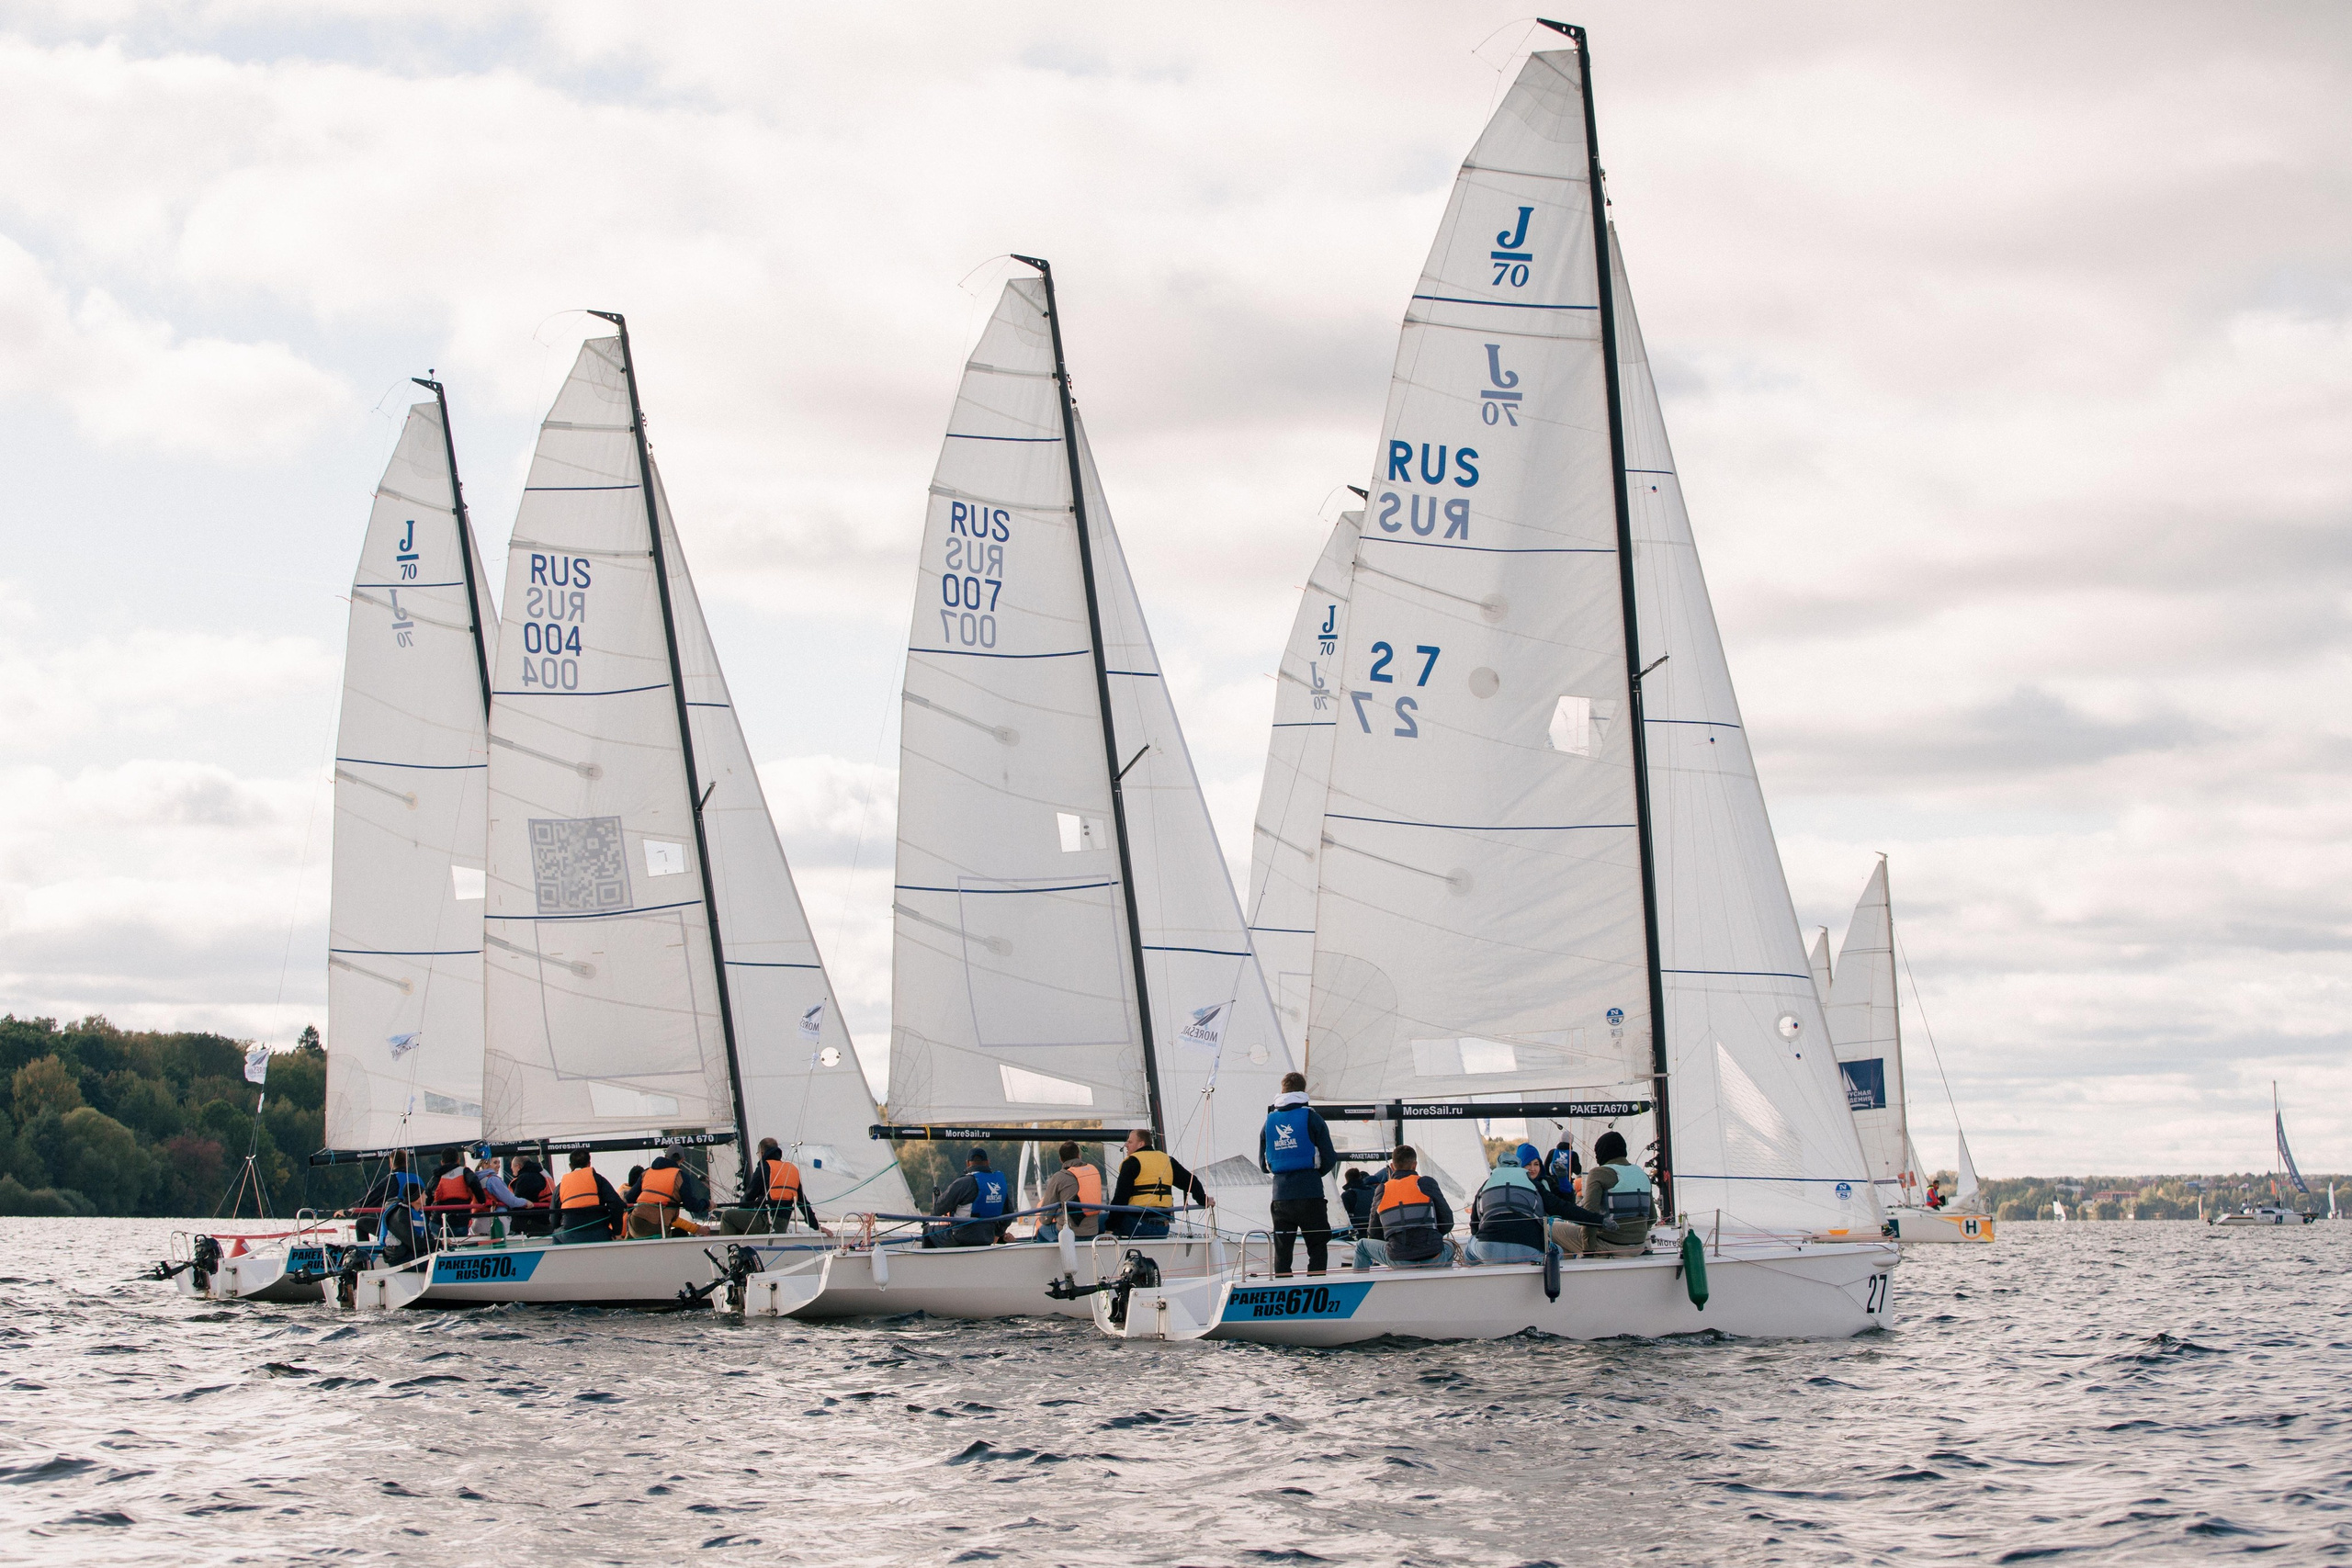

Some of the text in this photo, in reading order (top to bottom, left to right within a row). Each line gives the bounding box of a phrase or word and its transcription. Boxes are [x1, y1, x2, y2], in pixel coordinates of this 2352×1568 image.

[1496, 206, 1535, 250] J
[1492, 262, 1530, 288] 70
[1388, 439, 1479, 488] RUS
[399, 520, 415, 552] J
[951, 501, 1010, 543] RUS
[400, 563, 418, 581] 70
[531, 553, 592, 589] RUS
[942, 573, 1002, 613] 007
[1321, 604, 1337, 634] J
[524, 622, 582, 657] 004
[1320, 641, 1335, 656] 70
[1403, 1106, 1463, 1115] MoreSail.ru
[548, 1142, 591, 1150] moresail.ru
[695, 1134, 714, 1143] 670
[945, 1129, 990, 1138] MoreSail.ru
[456, 1268, 479, 1280] RUS
[479, 1256, 512, 1279] 670
[1253, 1287, 1340, 1317] RUS 670 27
[1866, 1274, 1888, 1314] 27
